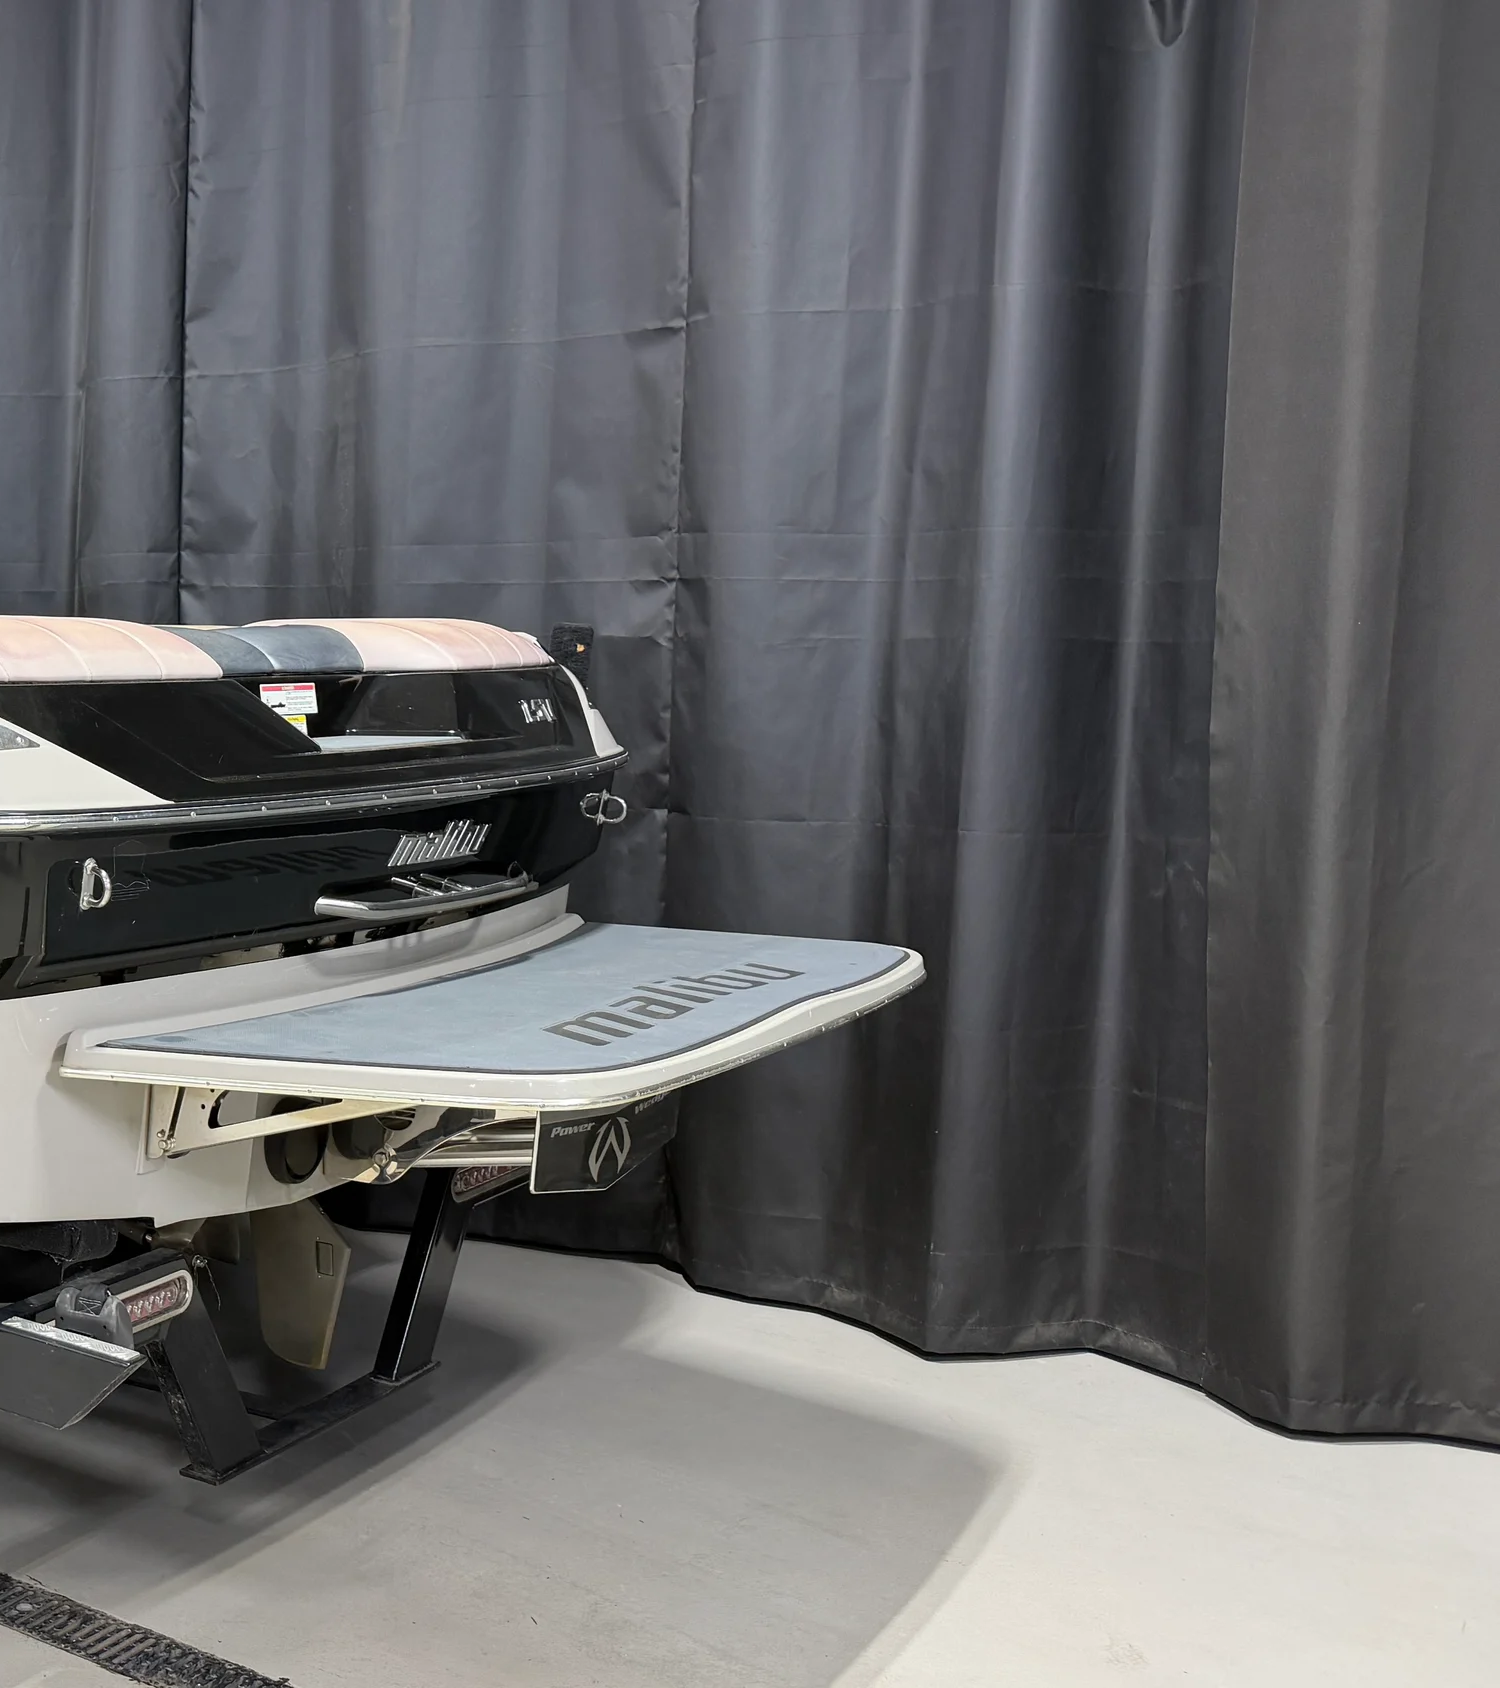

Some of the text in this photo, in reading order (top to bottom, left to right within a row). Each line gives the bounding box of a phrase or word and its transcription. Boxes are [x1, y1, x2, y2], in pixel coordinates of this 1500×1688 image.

[387, 818, 492, 867] malibu
[542, 962, 806, 1047] malibu
[550, 1121, 596, 1138] Power
